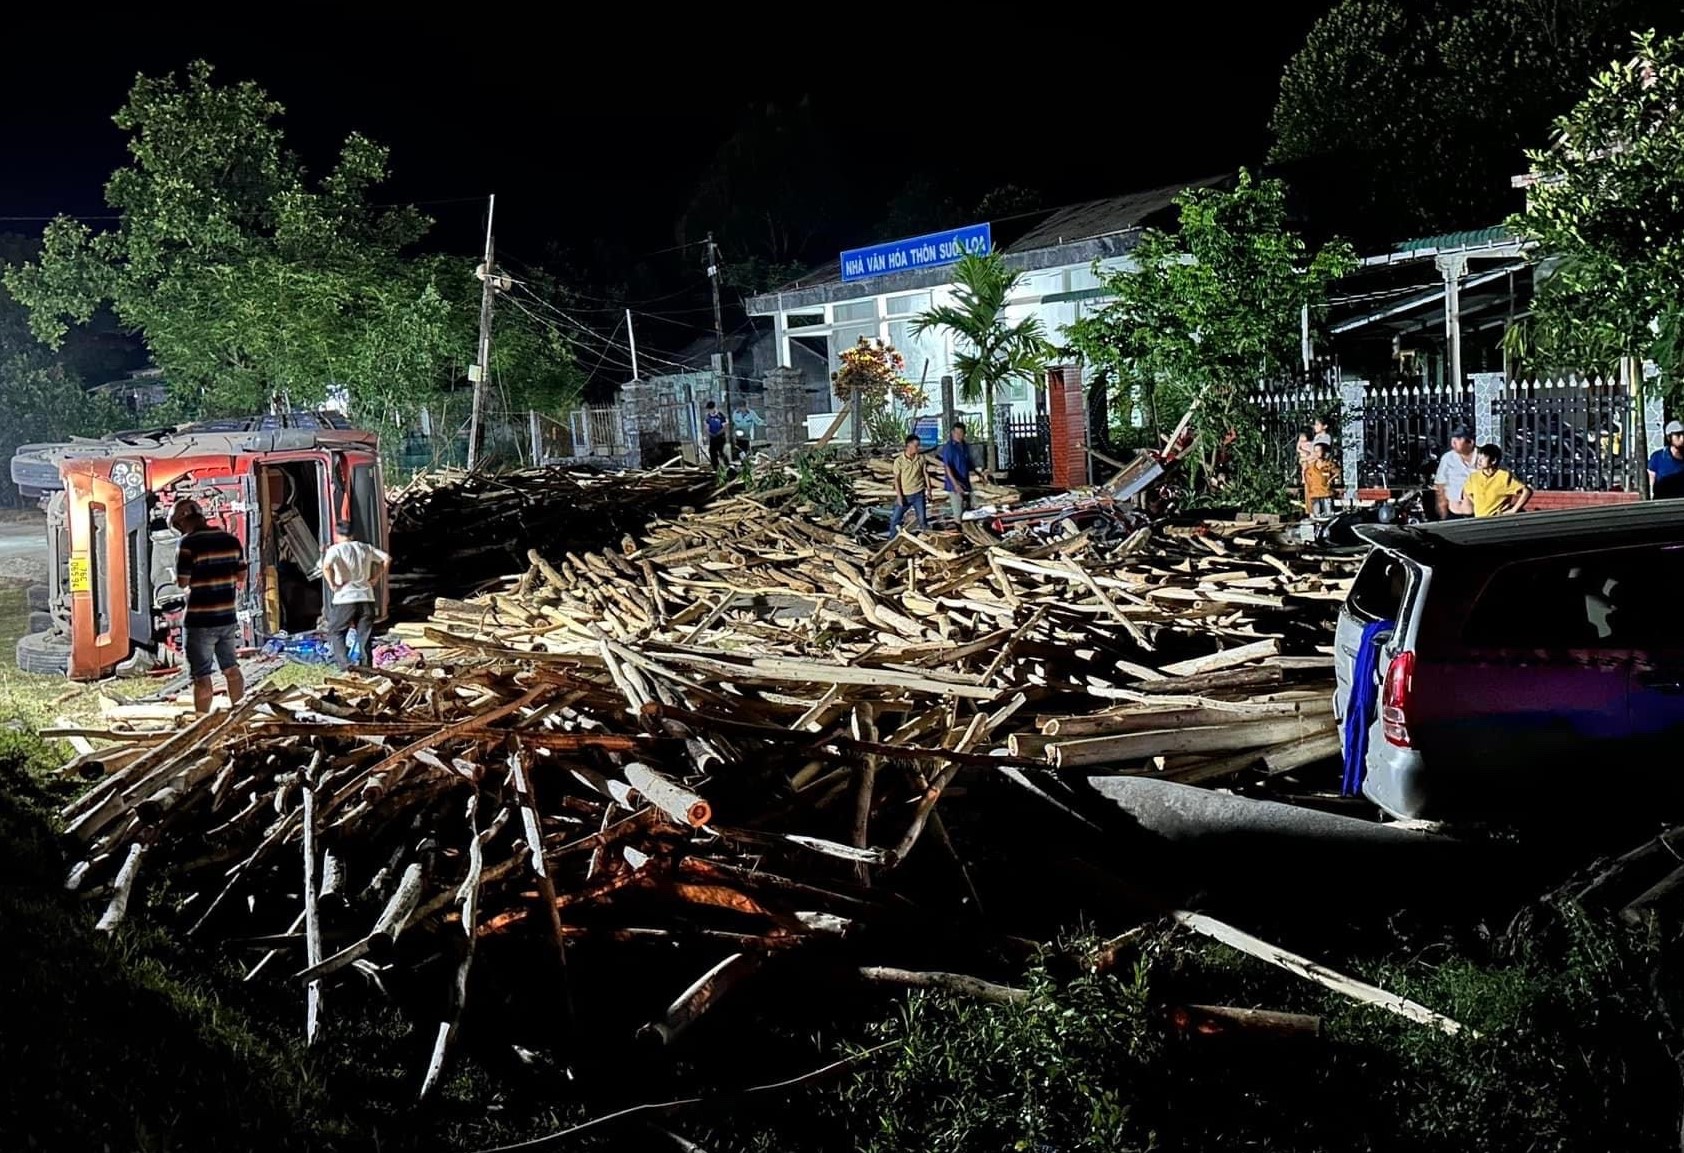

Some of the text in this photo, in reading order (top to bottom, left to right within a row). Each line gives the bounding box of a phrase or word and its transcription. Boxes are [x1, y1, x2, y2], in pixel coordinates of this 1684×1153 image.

[846, 255, 865, 276] NHÀ
[867, 252, 886, 272] VĂN
[889, 247, 908, 268] HÓA
[910, 243, 937, 264] THÔN
[939, 235, 964, 260] SUỐ
